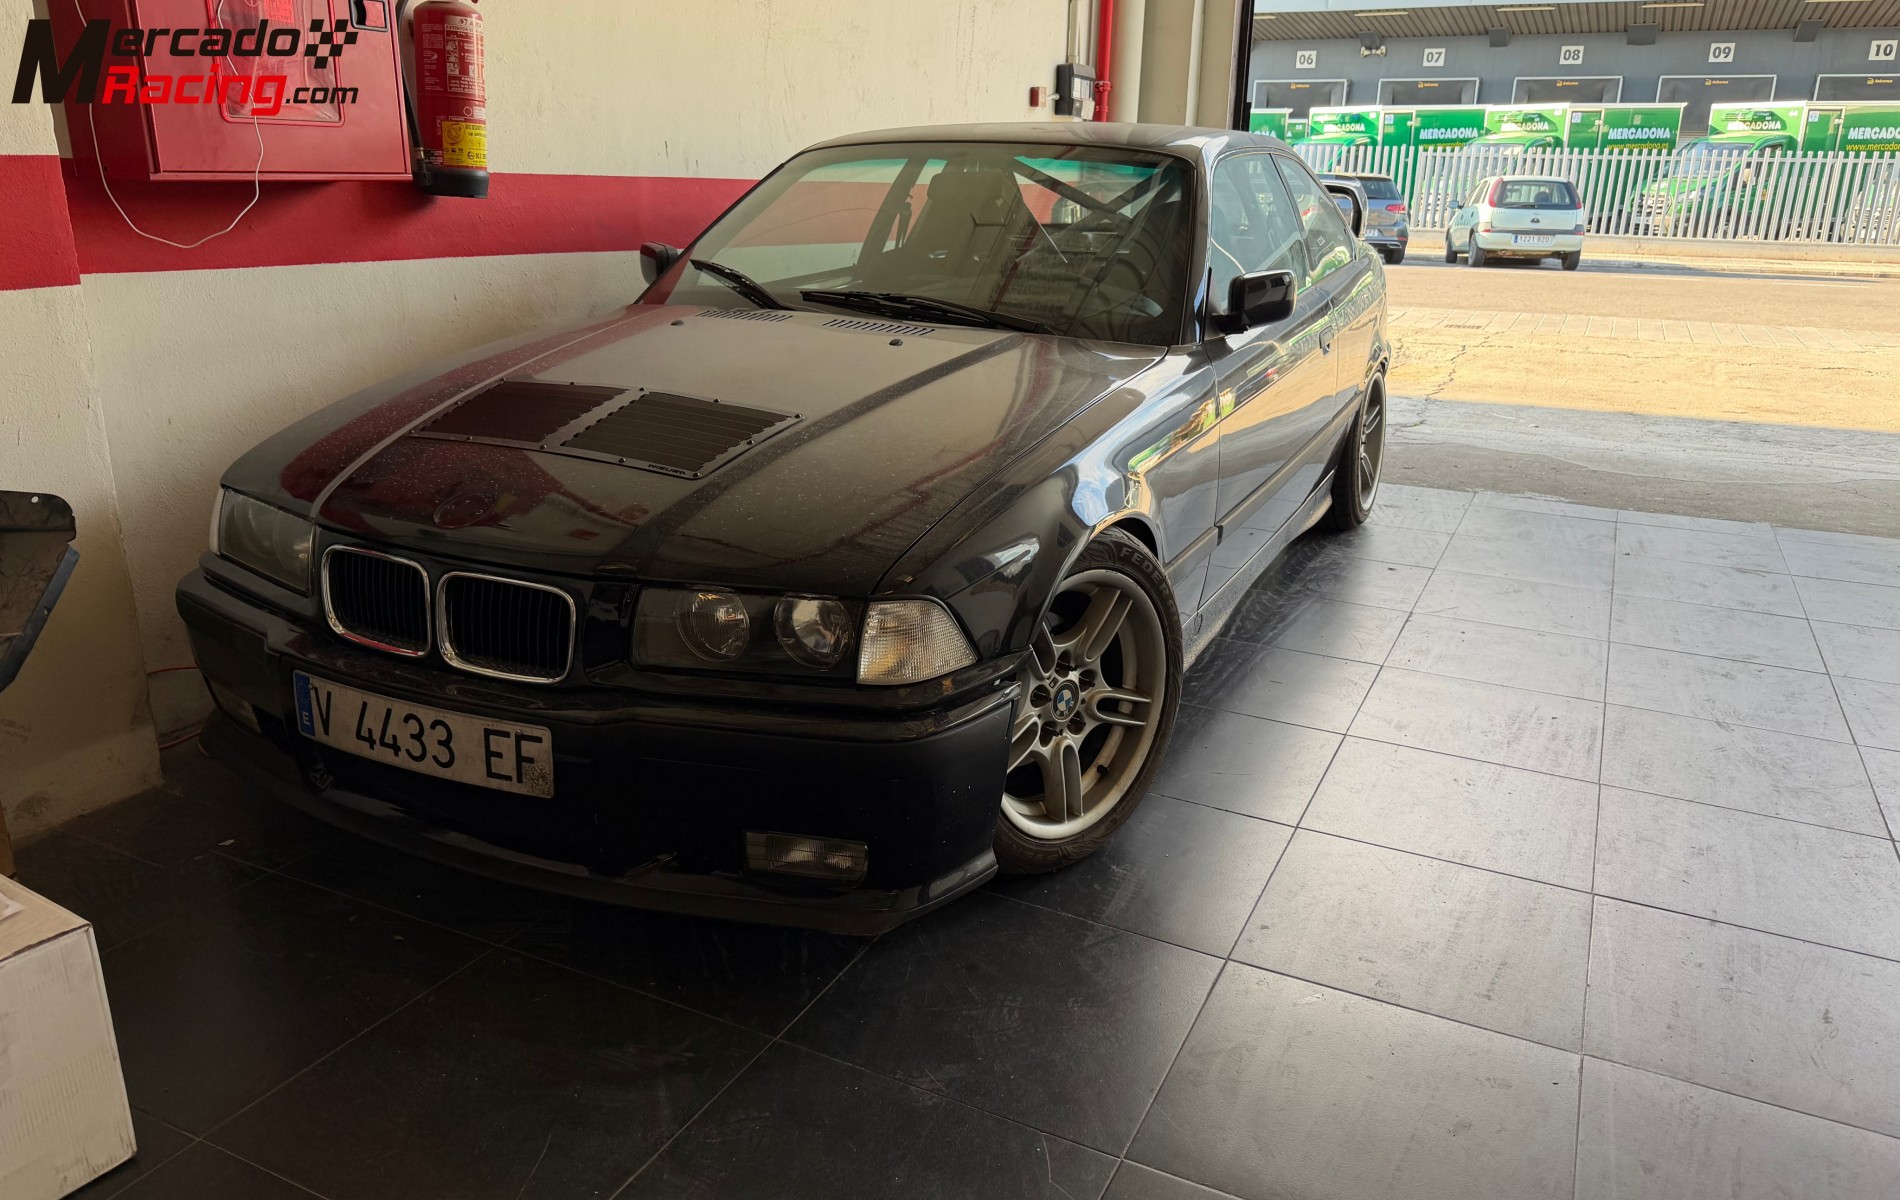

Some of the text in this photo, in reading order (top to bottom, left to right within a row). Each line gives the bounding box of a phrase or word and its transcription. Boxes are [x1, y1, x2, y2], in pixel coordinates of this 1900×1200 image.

[1563, 49, 1581, 61] 08
[1712, 46, 1732, 59] 09
[1875, 43, 1894, 57] 10
[1299, 54, 1314, 65] 06
[1426, 52, 1443, 63] 07
[1323, 123, 1366, 132] CADONA
[1501, 121, 1549, 132] CADONA
[1420, 127, 1479, 140] MERCADONA
[1608, 127, 1671, 140] MERCADONA
[302, 711, 311, 727] E
[313, 685, 544, 784] V 4433 EF
